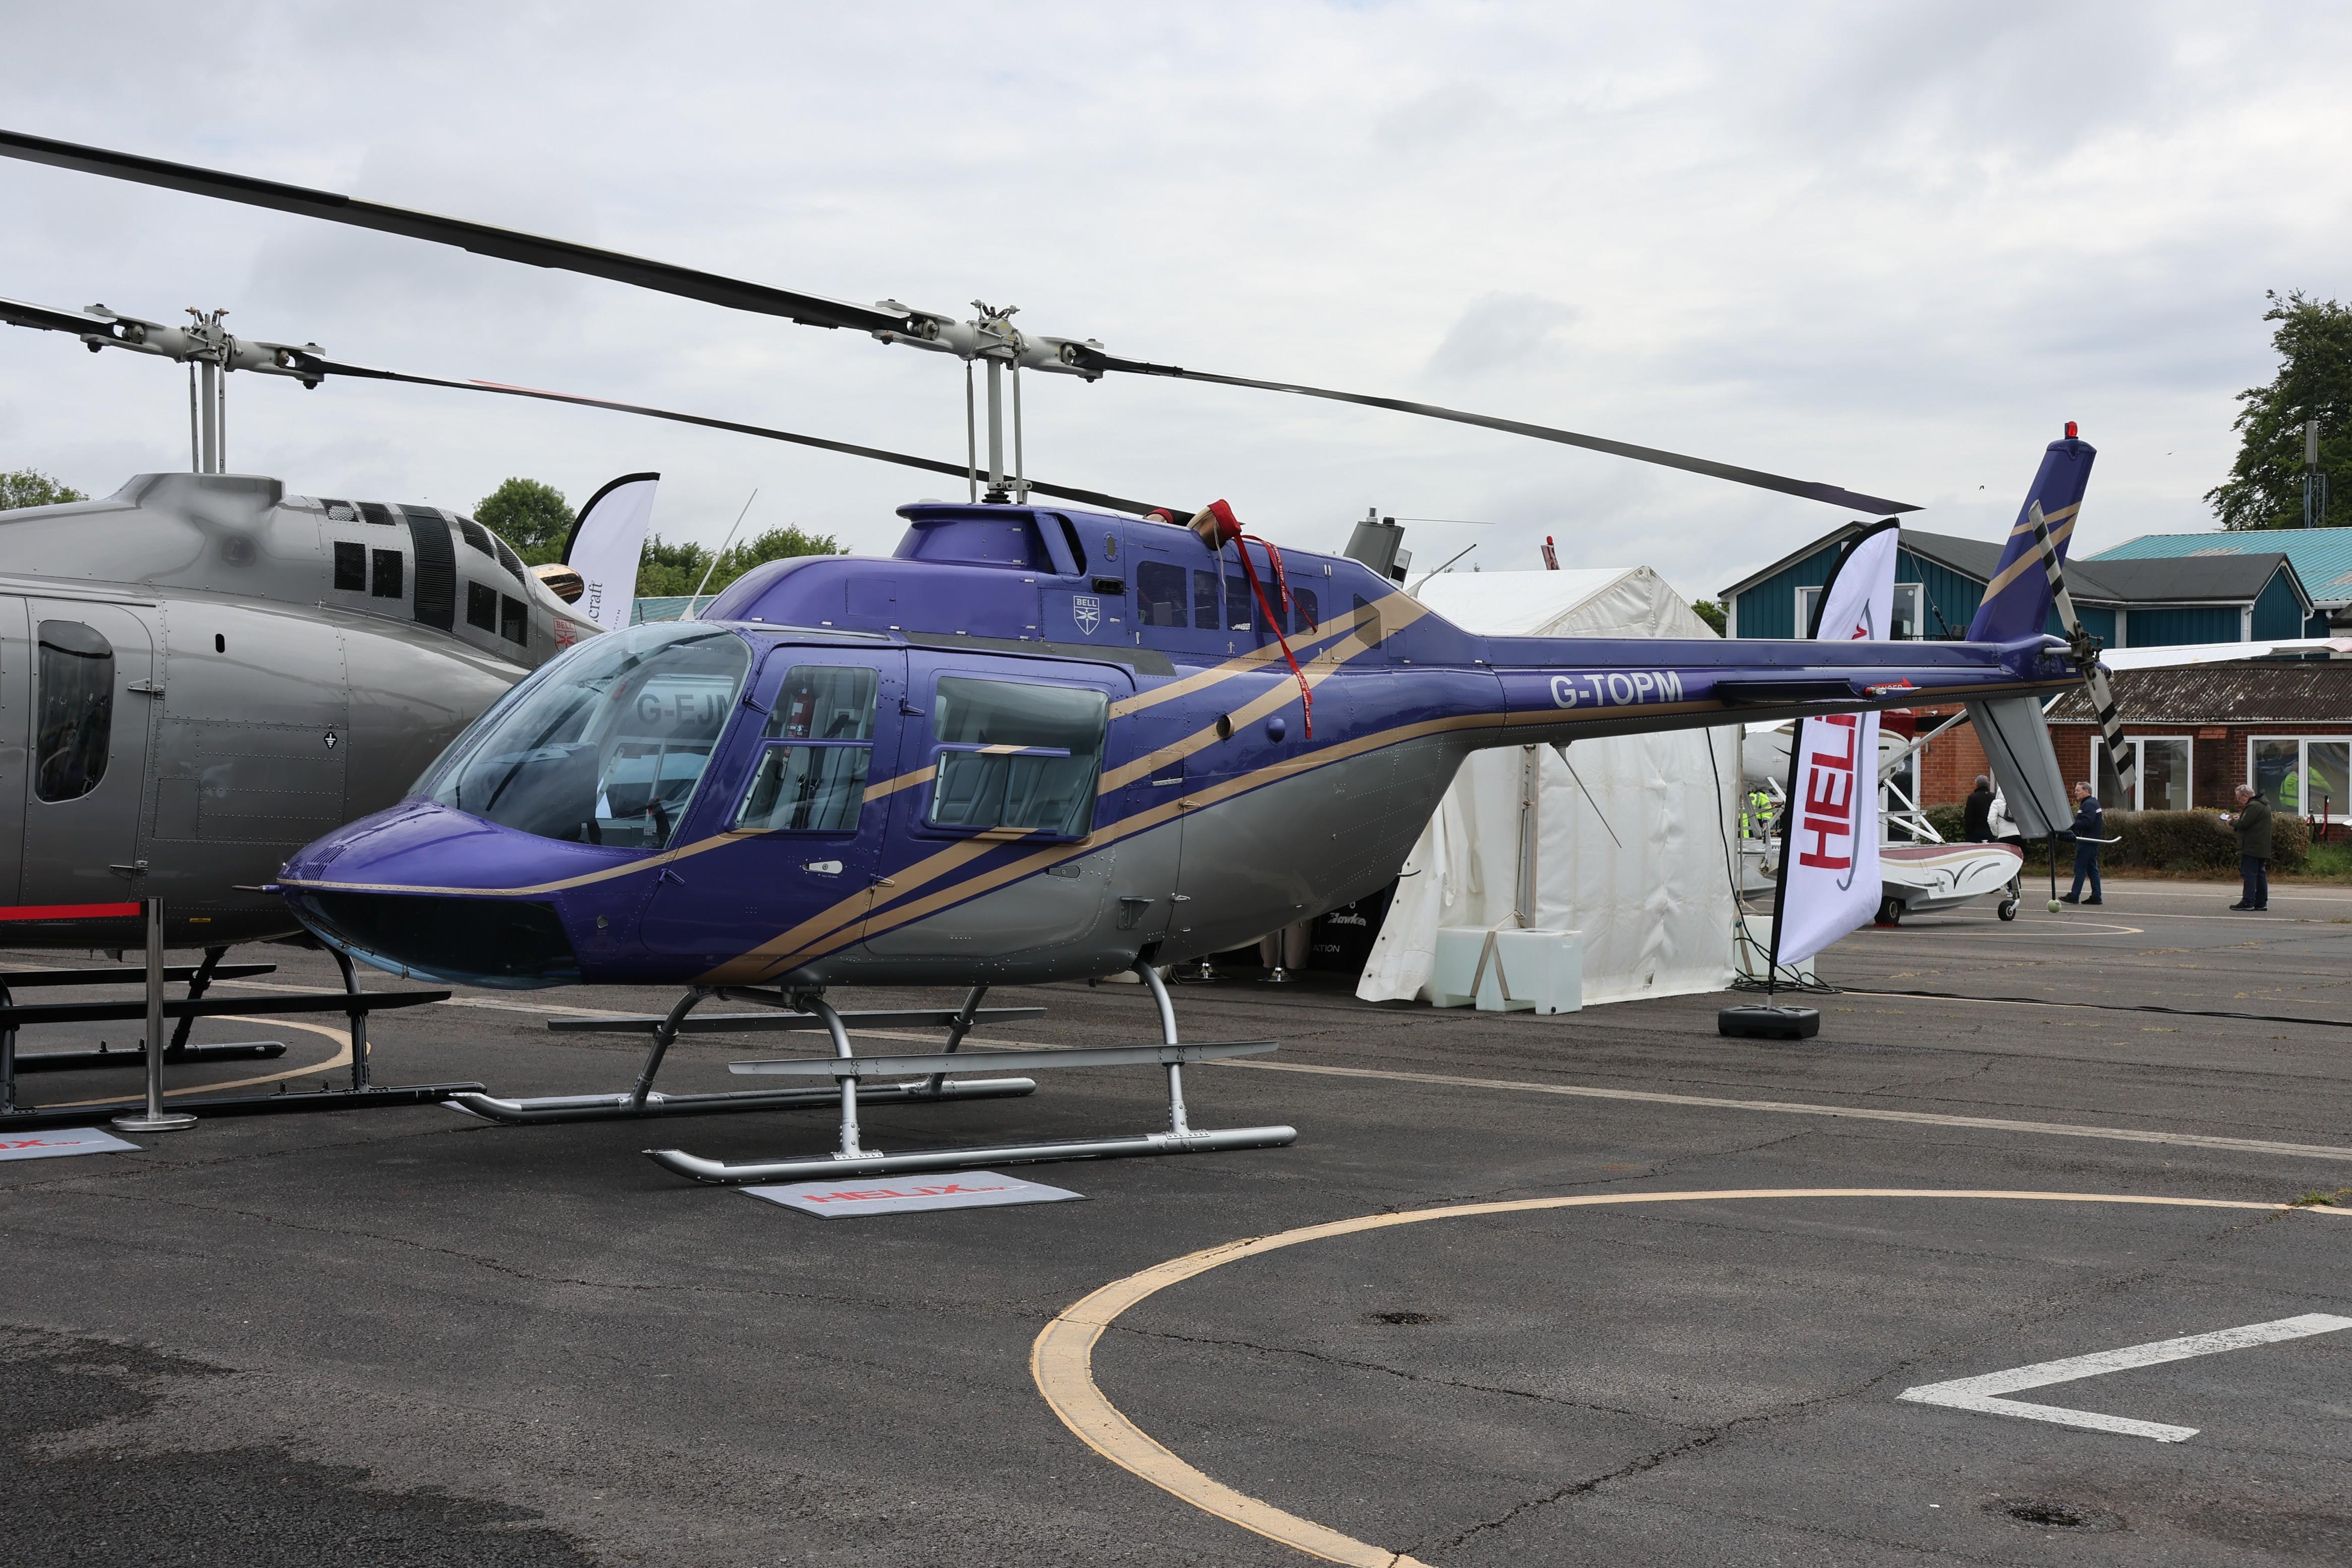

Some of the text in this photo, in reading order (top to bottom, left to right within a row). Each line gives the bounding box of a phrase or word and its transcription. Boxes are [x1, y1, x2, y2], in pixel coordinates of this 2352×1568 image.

[1273, 546, 1281, 563] REMOVE
[1076, 598, 1097, 607] BELL
[555, 620, 575, 630] BELL
[613, 609, 621, 630] TION
[1295, 671, 1306, 689] REMOVE
[1550, 671, 1683, 709] G-TOPM
[1311, 944, 1340, 953] ATION
